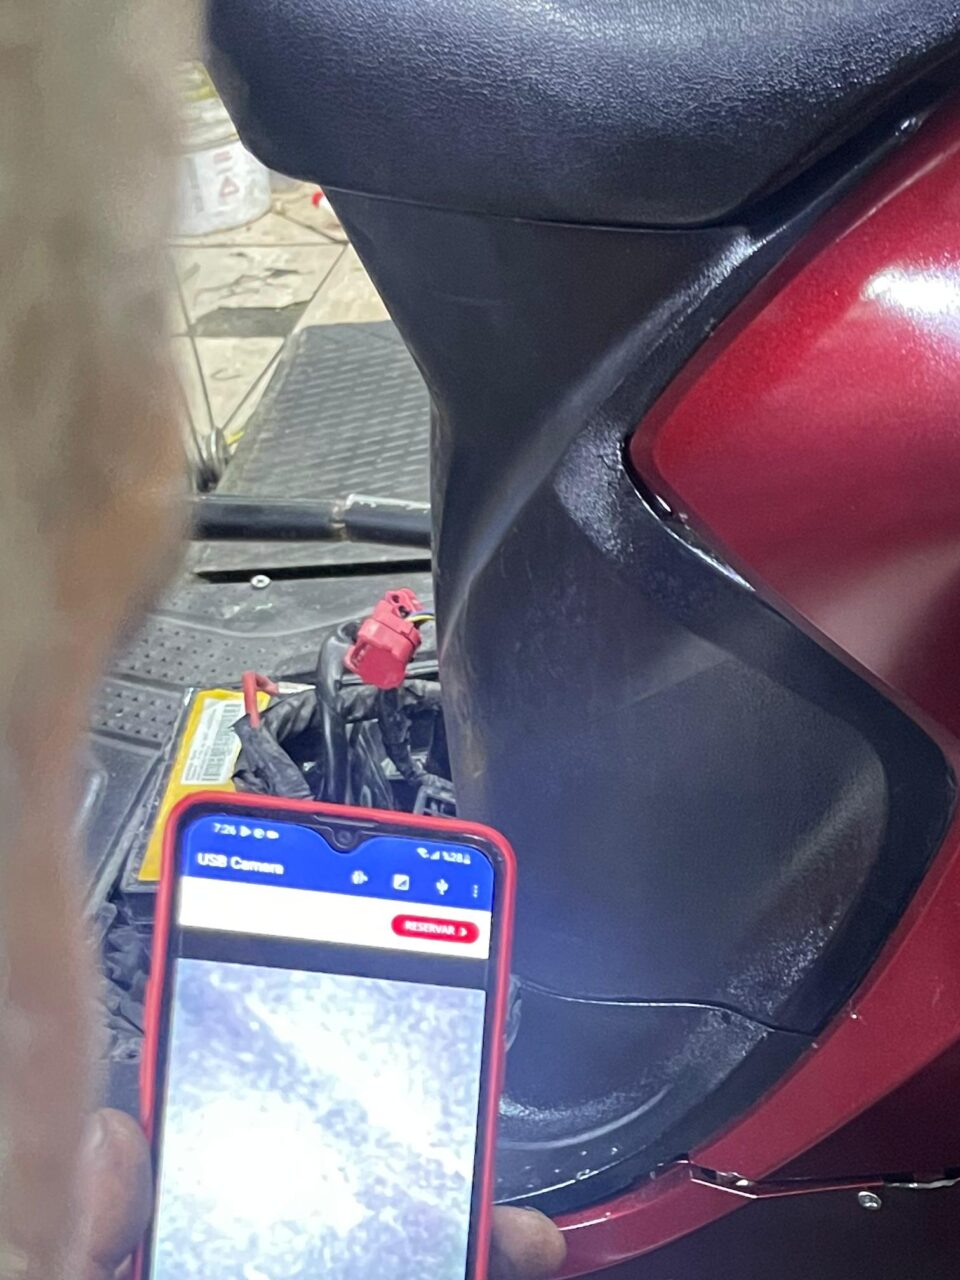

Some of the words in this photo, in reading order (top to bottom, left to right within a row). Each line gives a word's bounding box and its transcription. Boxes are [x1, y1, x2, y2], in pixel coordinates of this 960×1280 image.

[197, 852, 228, 868] USB
[230, 856, 284, 875] Camera
[404, 920, 455, 935] RESERVAR
